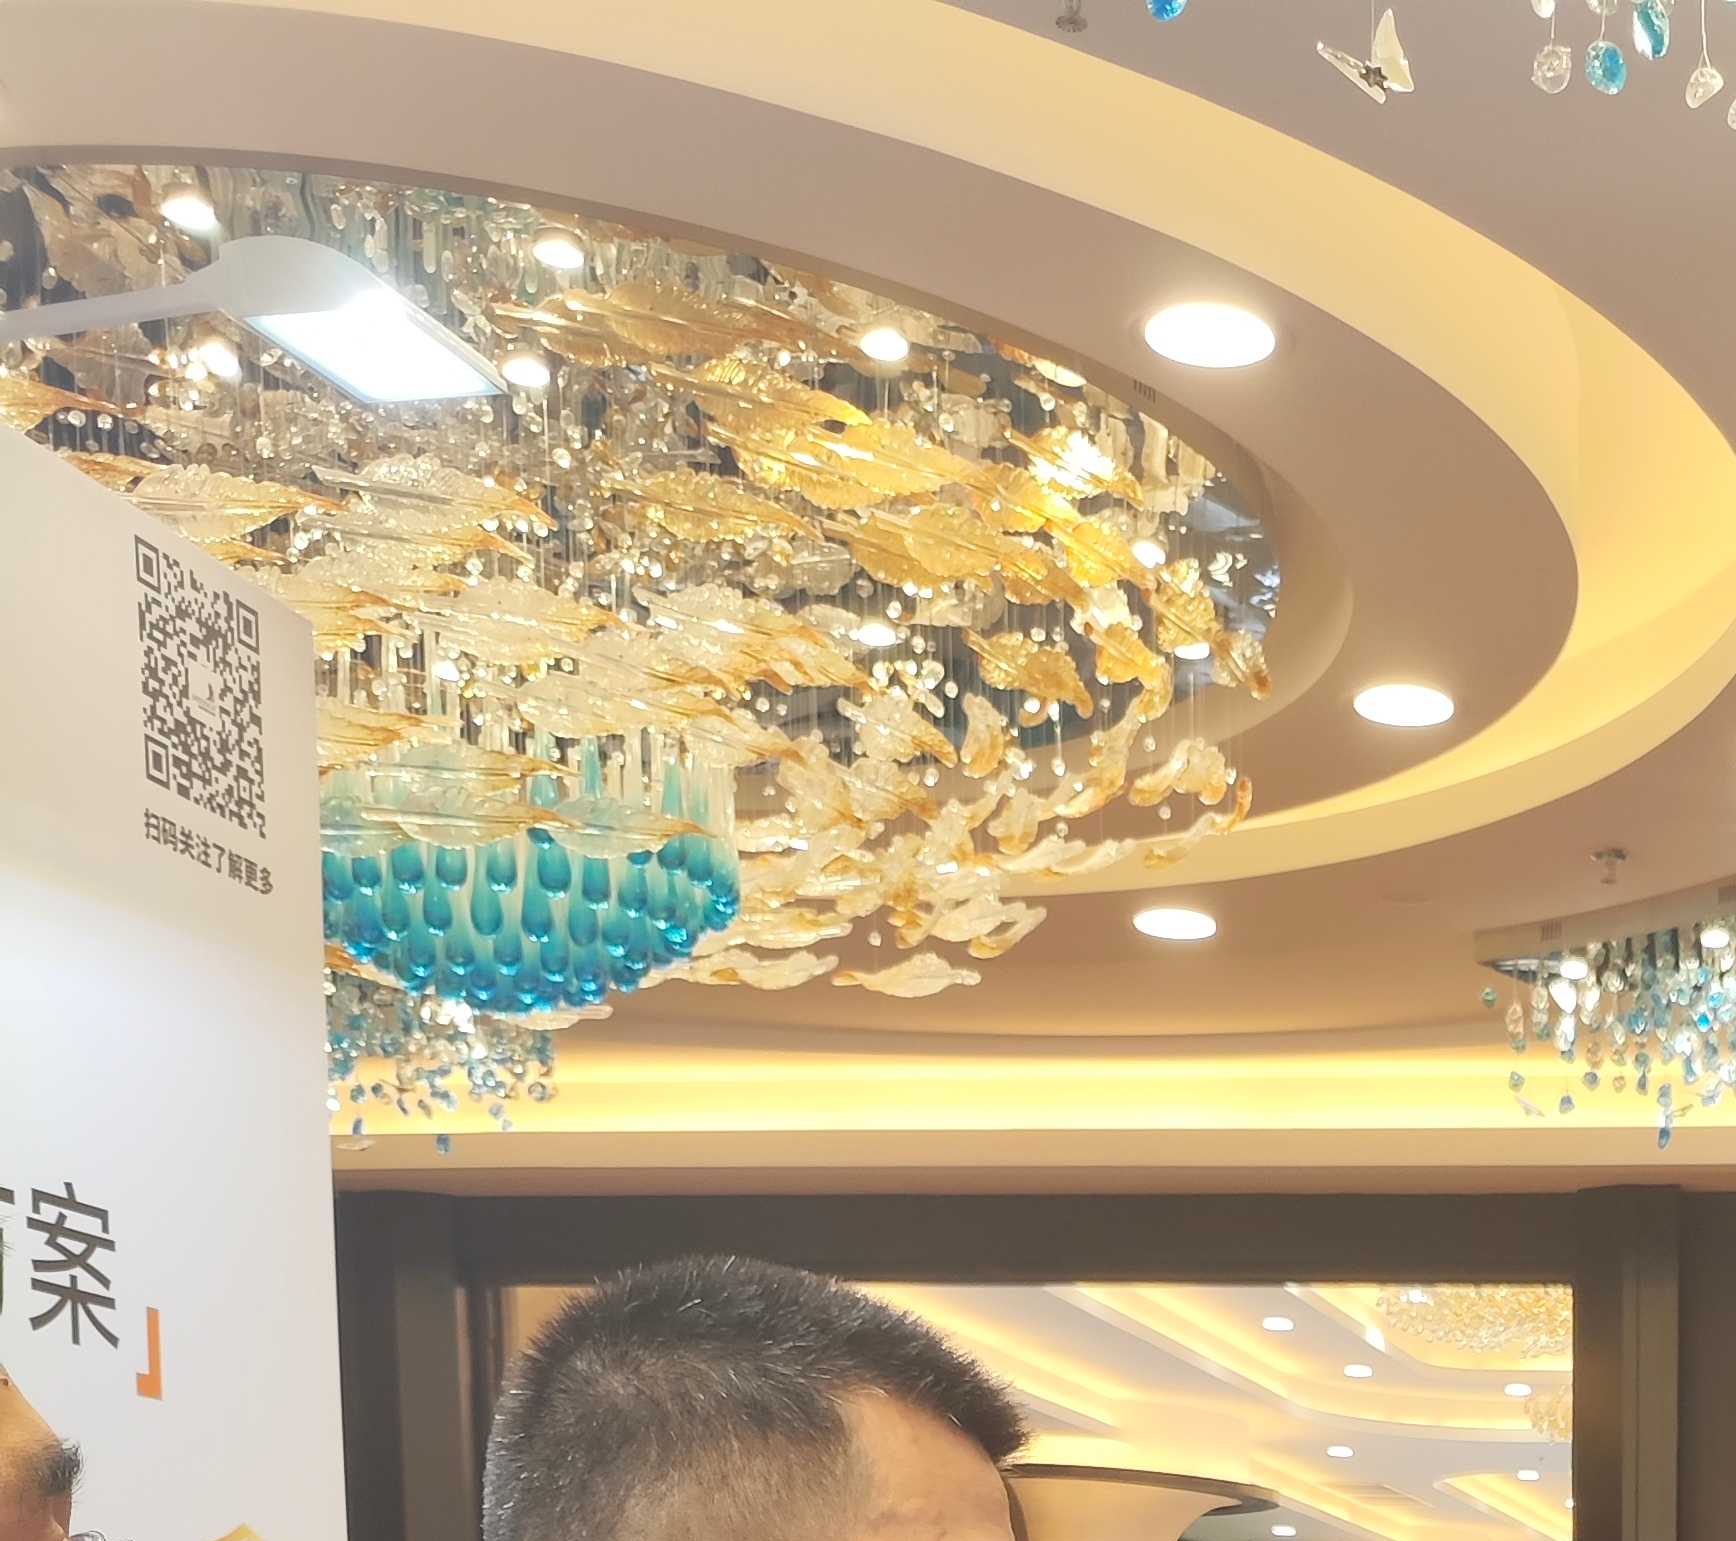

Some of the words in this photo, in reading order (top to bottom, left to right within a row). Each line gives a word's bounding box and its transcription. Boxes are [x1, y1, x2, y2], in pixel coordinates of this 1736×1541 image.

[143, 807, 274, 896] 扫码关注了解更多
